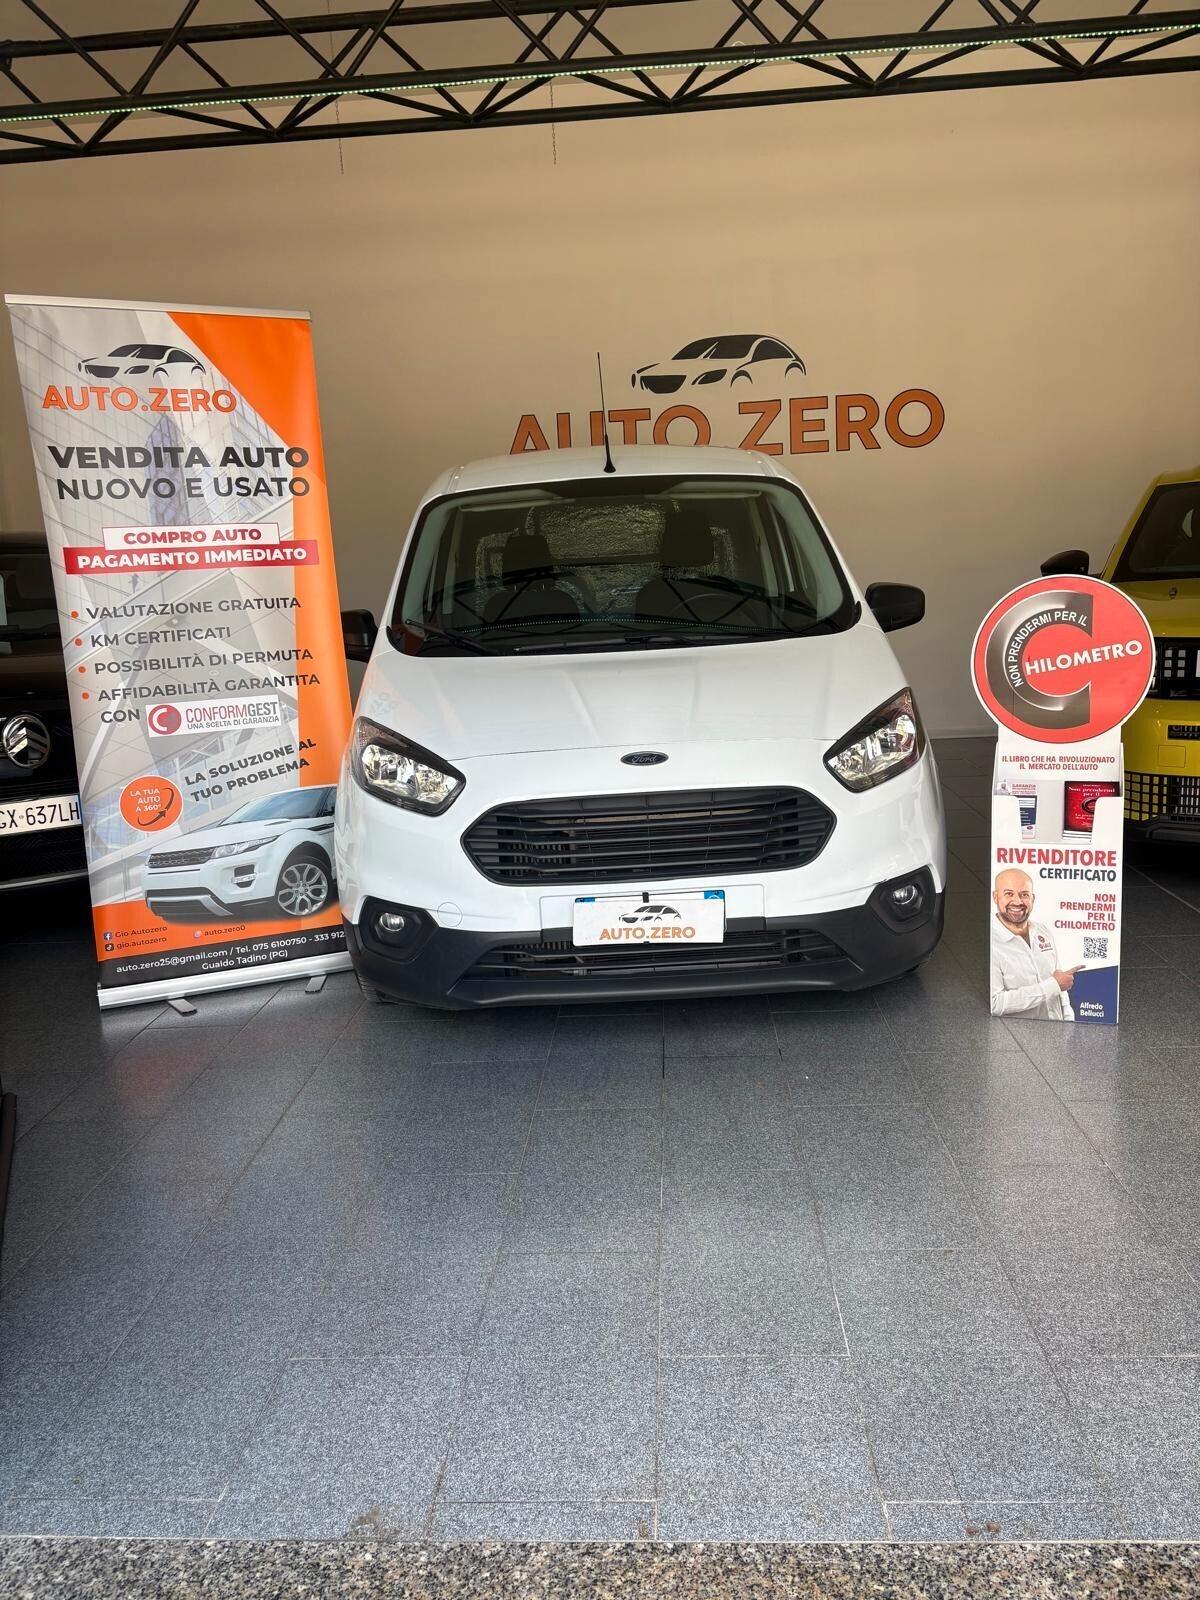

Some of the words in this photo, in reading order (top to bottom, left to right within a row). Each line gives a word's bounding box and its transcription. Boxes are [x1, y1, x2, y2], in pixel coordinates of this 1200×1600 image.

[42, 385, 237, 413] AUTO.ZERO
[738, 388, 945, 456] ZERO
[48, 446, 211, 469] VENDITA
[219, 447, 309, 468] AUTO
[57, 477, 176, 500] NUOVO
[187, 478, 204, 498] E
[213, 477, 310, 497] USATO
[123, 530, 207, 546] COMPRO
[212, 528, 262, 542] AUTO
[77, 551, 200, 569] PAGAMENTO
[204, 547, 307, 564] IMMEDIATO
[86, 601, 213, 620] VALUTAZIONE
[218, 597, 301, 612] GRATUITA
[1054, 611, 1077, 622] PER
[1078, 614, 1087, 626] IL
[91, 634, 119, 647] KM
[125, 627, 231, 645] CERTIFICATI
[1008, 612, 1052, 662] PRENDERMI
[95, 653, 204, 674] POSSIBILITÀ
[209, 653, 227, 666] DI
[233, 649, 313, 664] PERMUTA
[1008, 665, 1024, 688] NON
[98, 679, 220, 701] AFFIDABILITÀ
[225, 674, 320, 692] GARANTITA
[101, 709, 140, 724] CON
[186, 702, 278, 723] CONFORMGEST
[188, 722, 204, 730] UNA
[205, 720, 232, 728] SCELTA
[242, 716, 280, 725] GARANZIA
[184, 771, 206, 786] LA
[209, 747, 294, 778] SOLUZIONE
[298, 738, 317, 752] AL
[631, 754, 657, 764] Ford
[1028, 763, 1061, 771] MERCATO
[1062, 763, 1098, 771] DELL'AUTO
[1031, 756, 1045, 764] CHE
[1059, 756, 1115, 764] RIVOLUZIONATO
[190, 785, 223, 802] TUO
[226, 758, 310, 791] PROBLEMA
[137, 796, 160, 804] AUTO
[25, 802, 80, 825] 637LH
[997, 848, 1117, 867] RIVENDITORE
[1039, 868, 1116, 882] CERTIFICATO
[1094, 893, 1116, 902] NON
[1060, 901, 1116, 912] PRENDERMI
[1087, 912, 1106, 921] PER
[1108, 913, 1116, 921] IL
[115, 930, 130, 938] Gio
[131, 925, 168, 936] Autozero
[204, 925, 246, 937] auto.zero0
[600, 926, 696, 940] AUTO.ZERO
[1054, 920, 1116, 931] CHILOMETRO
[116, 937, 167, 950] gio.autozero
[116, 949, 228, 973] auto.zero25@gmail.com
[229, 947, 235, 956] /
[235, 944, 251, 954] Tel.
[252, 941, 269, 951] 075
[271, 936, 307, 949] 6100750
[314, 933, 329, 943] 333
[202, 958, 234, 971] Gualdo
[236, 953, 267, 966] Tadino
[269, 949, 288, 960] (PG)
[1080, 1002, 1103, 1011] Alfredo
[1080, 1010, 1104, 1018] Bellucci
